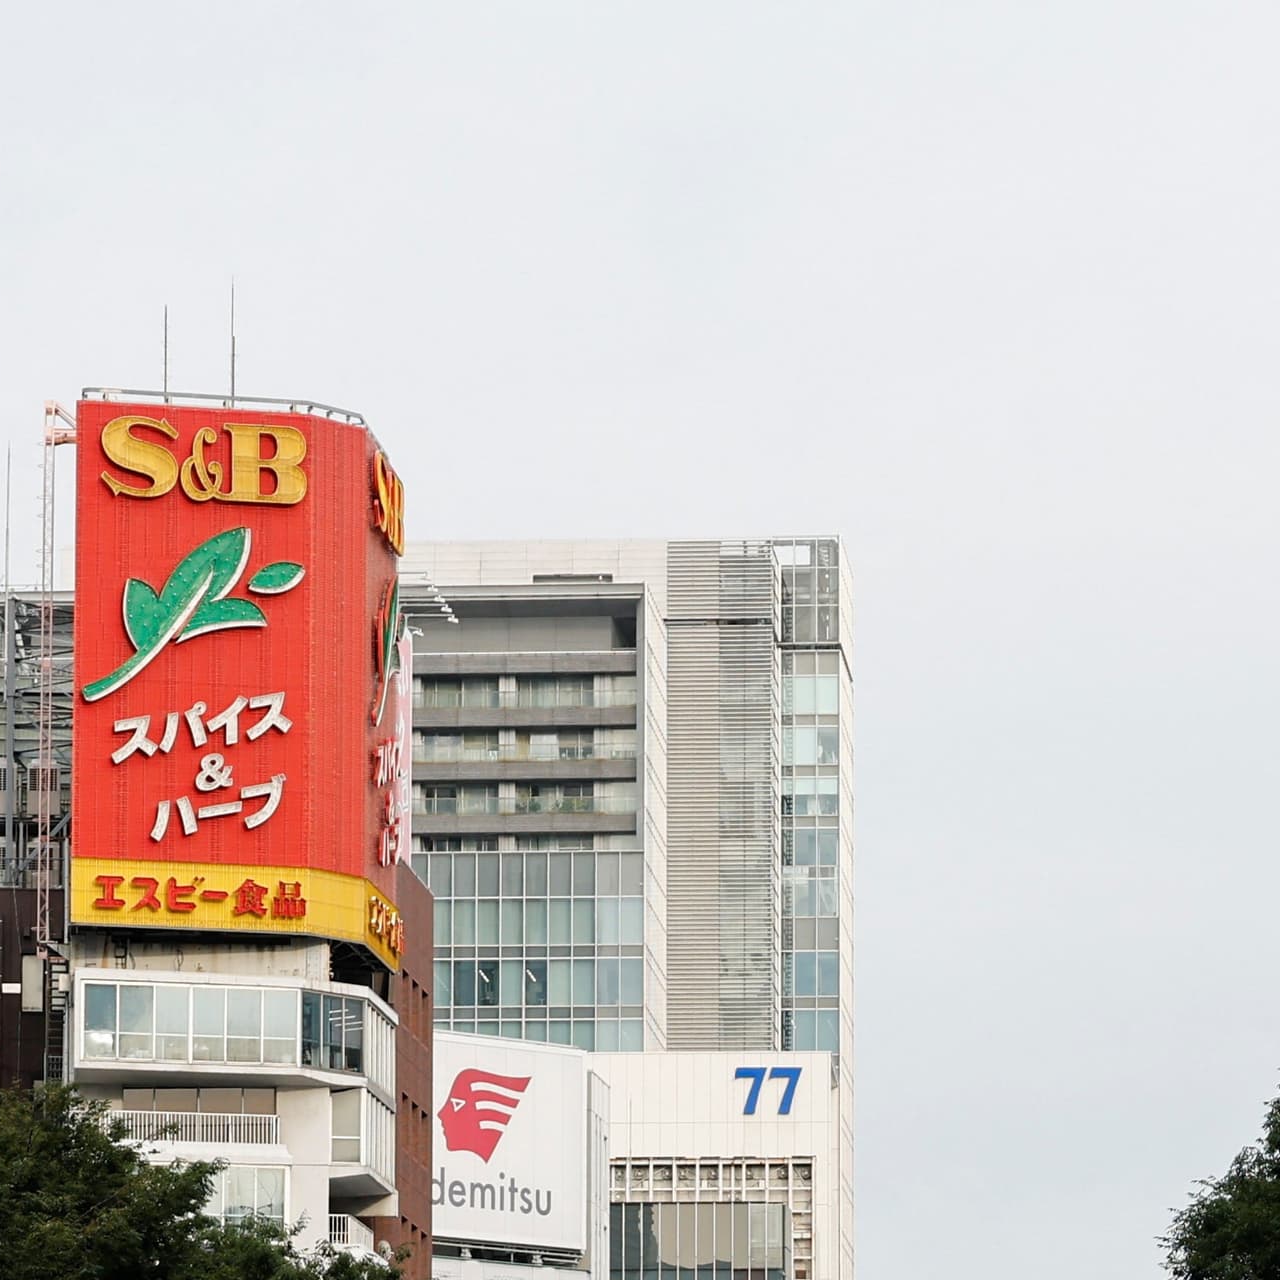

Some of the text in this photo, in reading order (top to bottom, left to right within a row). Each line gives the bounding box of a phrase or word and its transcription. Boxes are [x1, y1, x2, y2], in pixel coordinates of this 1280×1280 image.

[101, 415, 307, 505] S&B
[111, 691, 293, 765] スパイス
[195, 752, 233, 792] &
[150, 773, 287, 843] ハーブ
[94, 872, 307, 921] エスビー食品
[735, 1066, 802, 1115] 77
